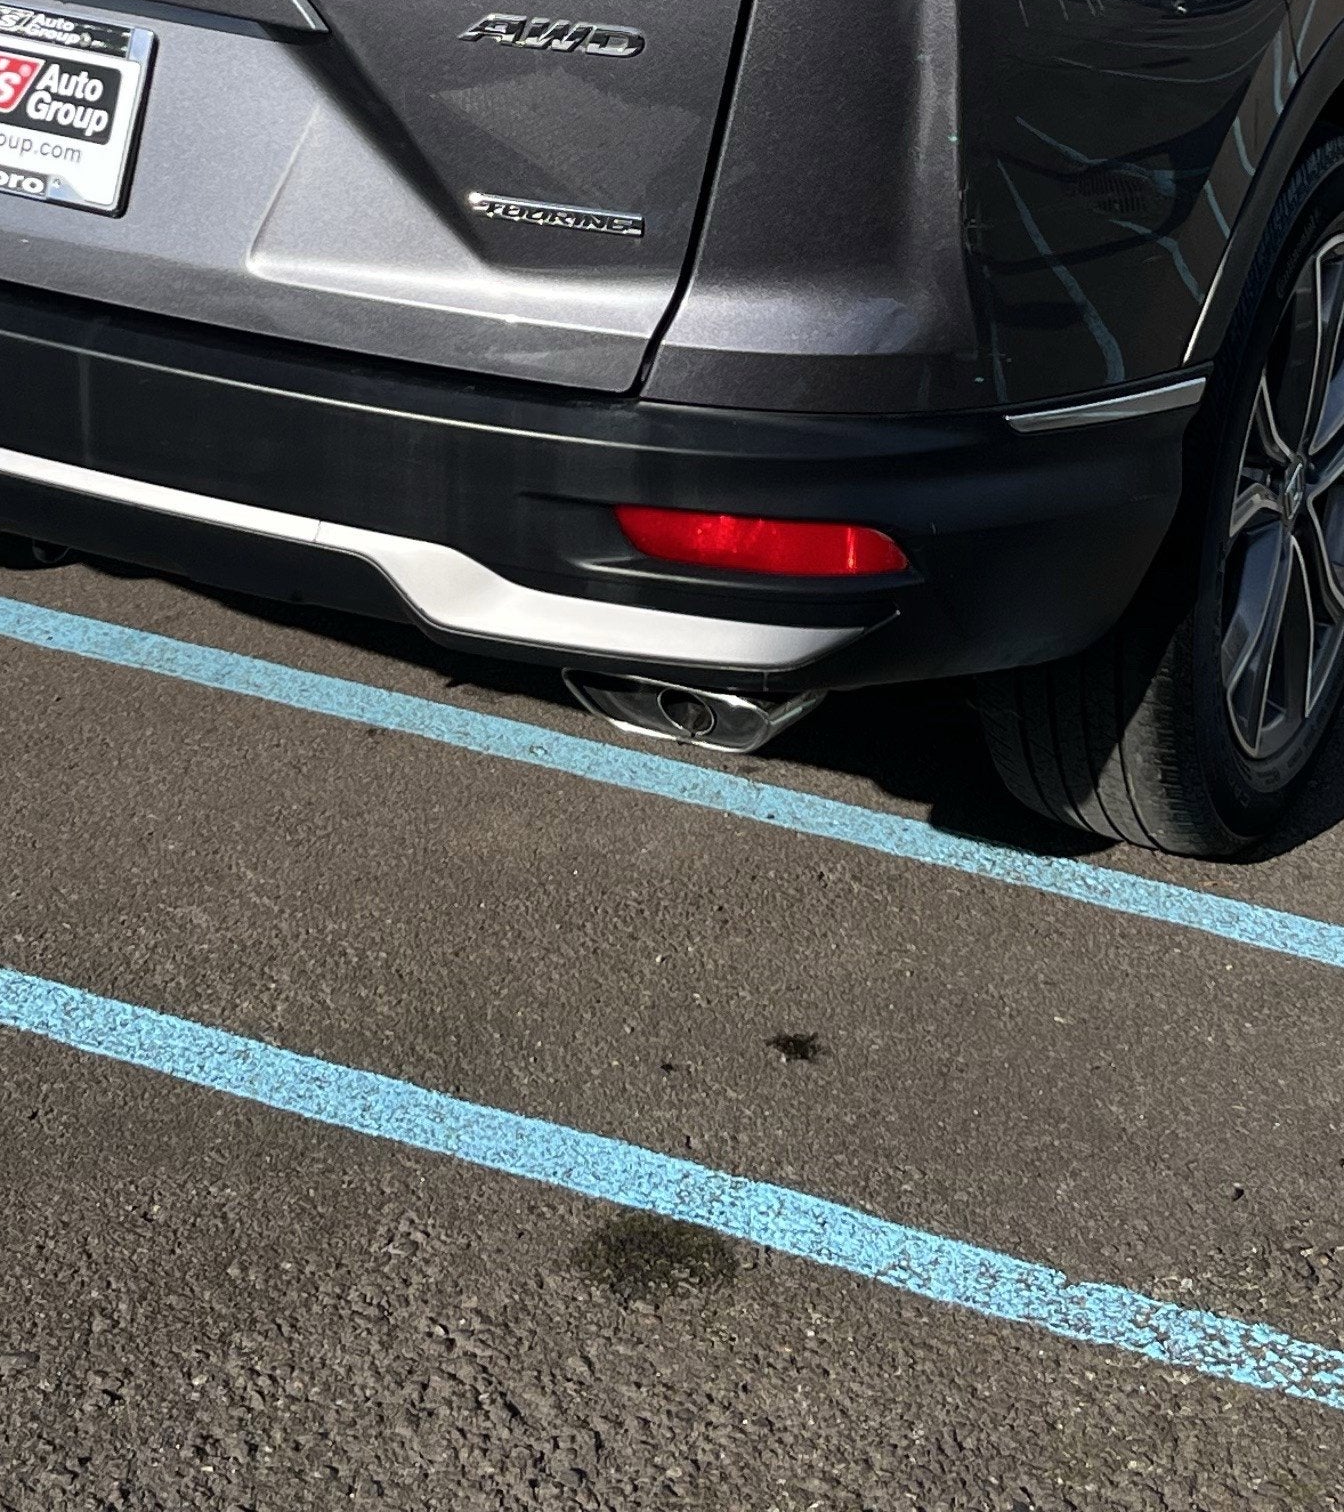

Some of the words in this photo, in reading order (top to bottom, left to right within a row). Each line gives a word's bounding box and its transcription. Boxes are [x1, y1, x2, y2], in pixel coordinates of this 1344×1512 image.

[30, 13, 75, 32] Auto
[458, 13, 646, 59] AWD
[35, 63, 104, 103] Auto
[26, 90, 109, 137] Group
